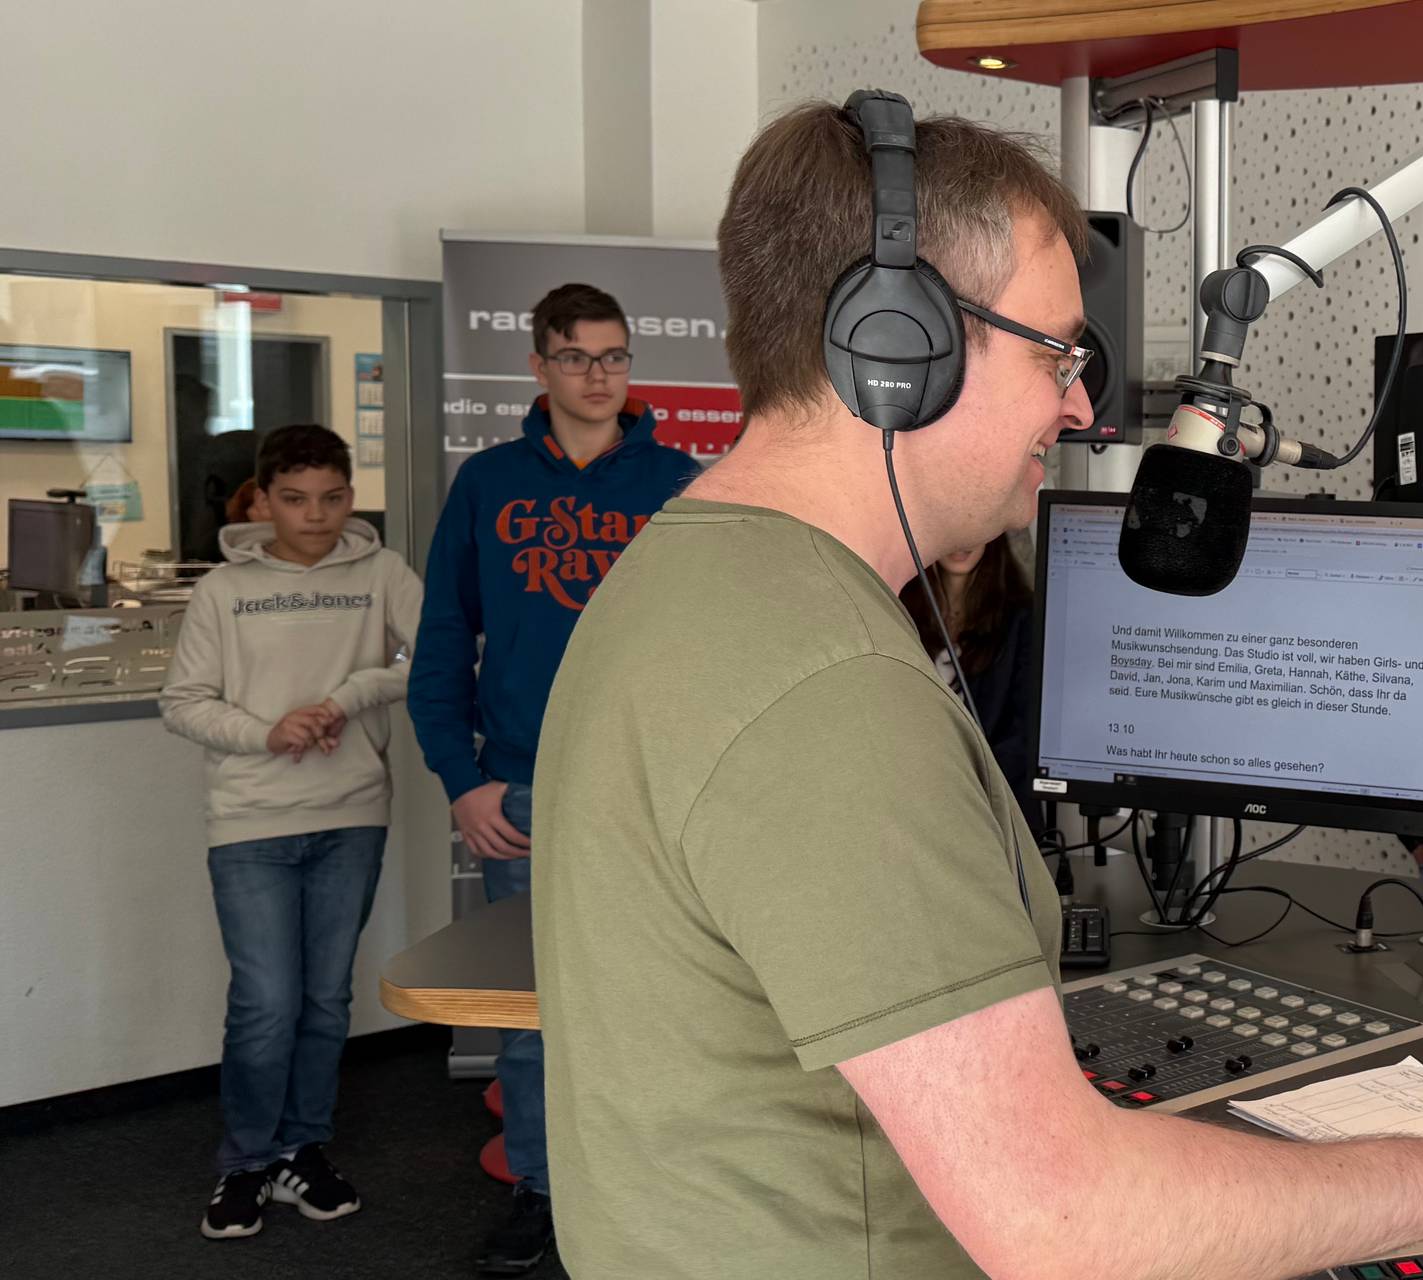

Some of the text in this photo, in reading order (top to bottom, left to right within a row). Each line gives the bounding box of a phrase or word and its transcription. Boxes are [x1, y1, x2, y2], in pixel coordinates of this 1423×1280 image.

[867, 379, 879, 387] HD
[880, 380, 895, 389] 280
[1112, 625, 1358, 650] Und damit Willkommen zu einer ganz besonderen
[1111, 640, 1221, 659] Musikwunschsendung.
[1224, 647, 1244, 658] Das
[1247, 649, 1279, 661] Studio
[1282, 652, 1294, 662] ist
[1297, 653, 1317, 664] voll,
[1320, 654, 1334, 664] wir
[1338, 655, 1370, 667] haben
[1373, 657, 1401, 668] Girls-
[1111, 655, 1414, 686] Boysday. Bei mir sind Emilia, Greta, Hannah, Käthe, Silvana,
[1110, 670, 1407, 701] David, Jan, Jona, Karim und Maximilian. Schön, dass Ihr da
[1110, 686, 1392, 716] seid. Eure Musikwünsche gibt es gleich in dieser Stunde.
[1106, 744, 1325, 774] Was habt Ihr heute schon so alles gesehen?
[1244, 803, 1267, 814] AOC
